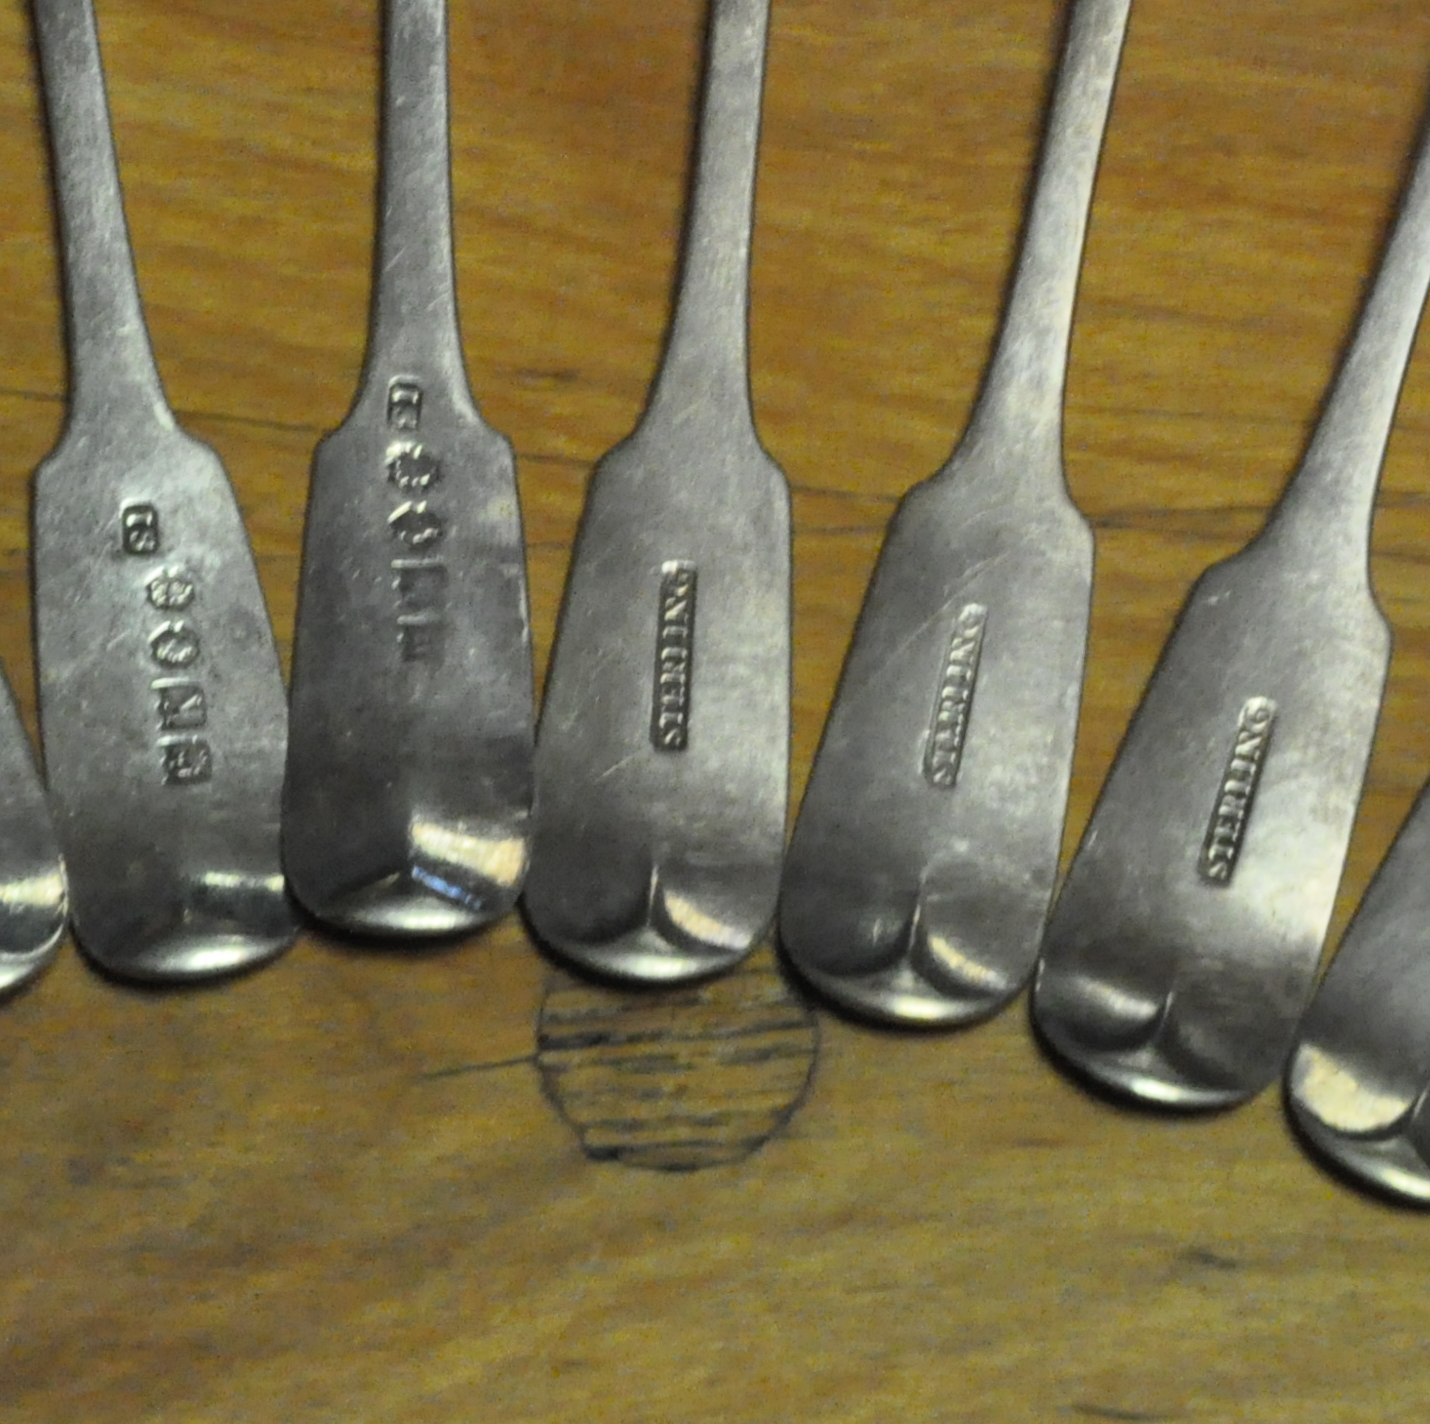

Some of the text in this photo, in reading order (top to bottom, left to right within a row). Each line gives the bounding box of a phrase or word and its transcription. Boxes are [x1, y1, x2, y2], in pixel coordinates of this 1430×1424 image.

[656, 567, 692, 752] STERLING
[930, 606, 982, 786] STERLING
[1205, 702, 1271, 880] STERLING
